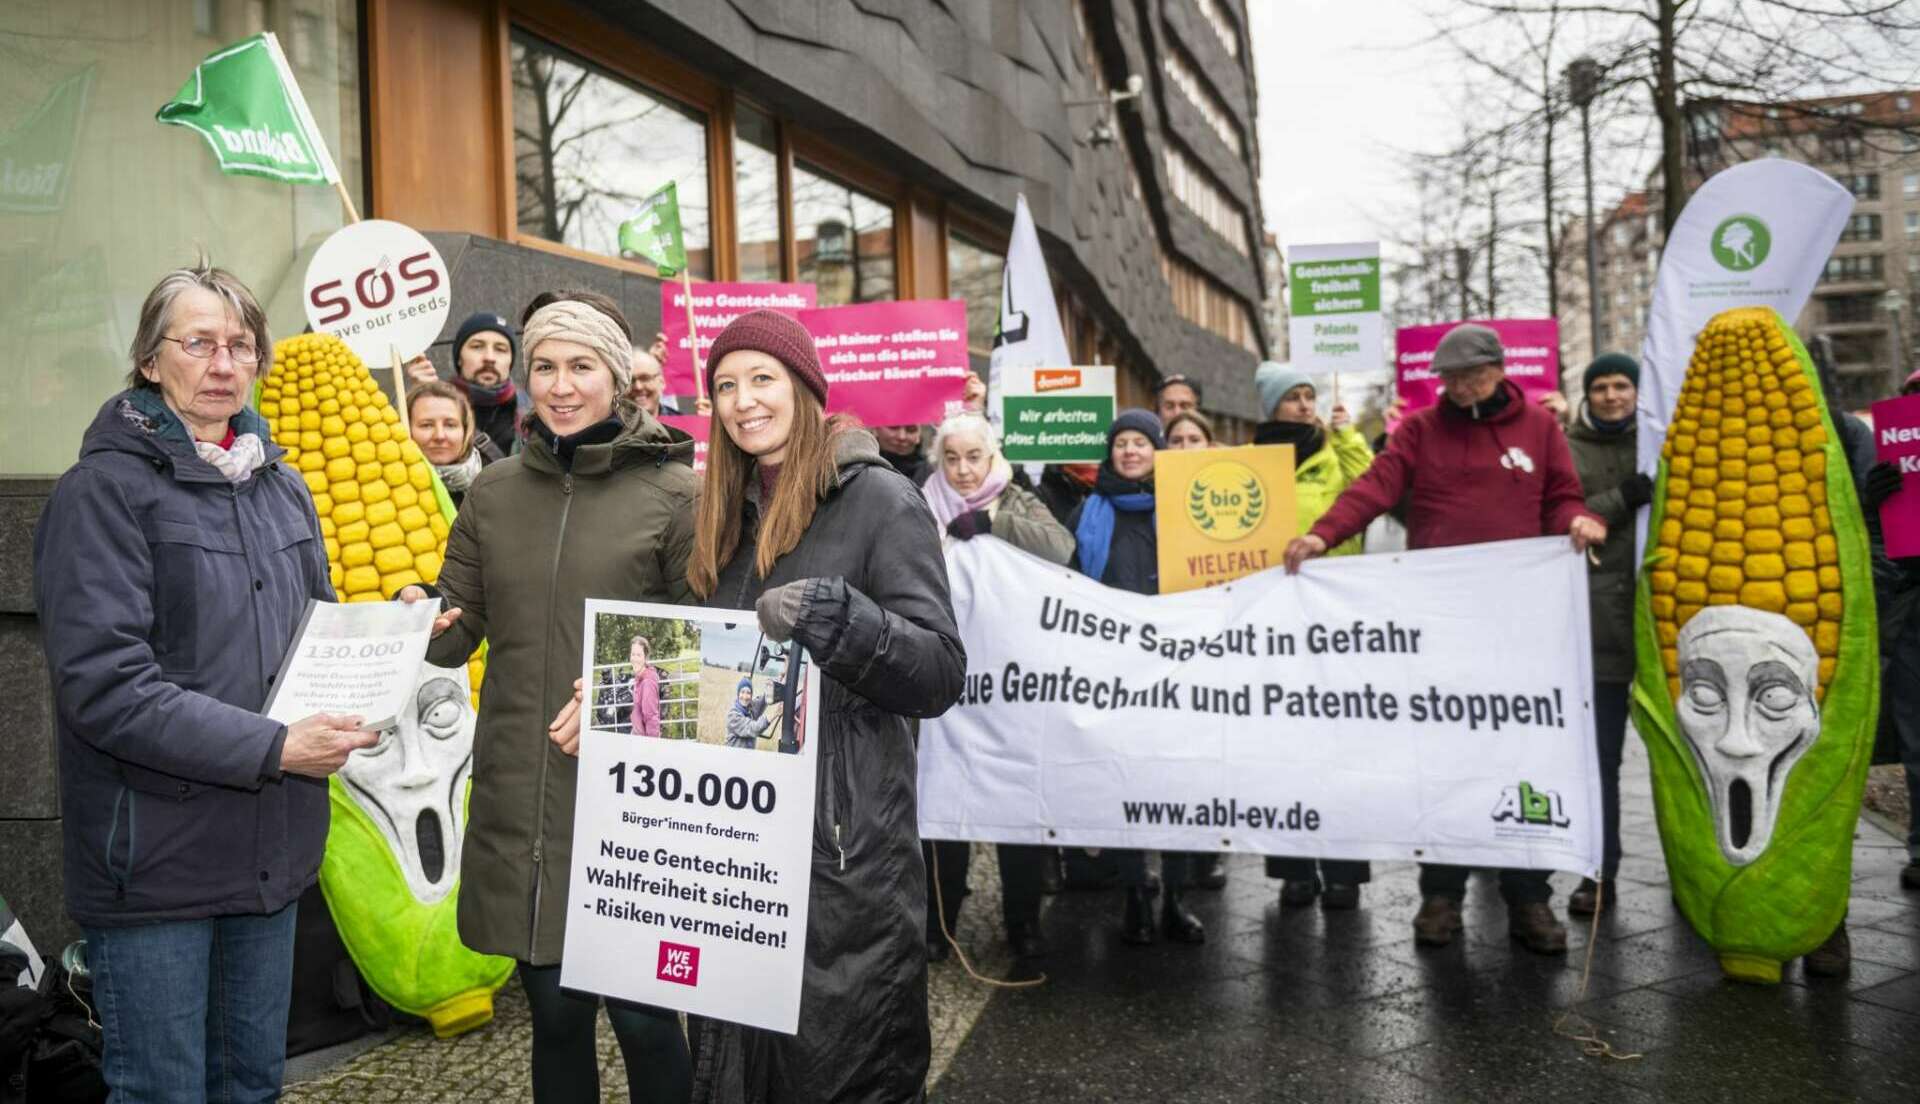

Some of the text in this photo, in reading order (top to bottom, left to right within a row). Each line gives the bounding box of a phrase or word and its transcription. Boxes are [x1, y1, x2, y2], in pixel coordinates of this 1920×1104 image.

[310, 252, 440, 326] SOS
[1311, 278, 1361, 294] freiheit
[674, 293, 807, 308] Nue Gentechnik:
[1313, 298, 1364, 311] sichern
[333, 296, 448, 338] ave our seeds
[839, 332, 881, 346] Rainer
[891, 329, 937, 343] stellen
[939, 329, 959, 341] Sie
[1314, 323, 1359, 336] Patente
[830, 347, 936, 364] sich an die Seite
[1314, 341, 1360, 356] stoppen
[1037, 375, 1077, 388] demeter
[1020, 408, 1097, 423] Wir arbeiten
[1005, 431, 1108, 446] ohne Gentechnik
[1210, 489, 1242, 507] bio
[1187, 550, 1268, 577] VIELFALT
[1039, 596, 1131, 644] Unser
[1266, 626, 1295, 656] in
[1307, 620, 1421, 654] Gefahr
[303, 641, 406, 659] 130.000
[1002, 661, 1181, 710] Gentechnik
[1191, 684, 1251, 716] und
[1263, 684, 1399, 721] Patente
[1409, 685, 1566, 731] stoppen!
[608, 761, 777, 814] 130.000
[1122, 798, 1320, 831] www.abl-ev.de
[705, 823, 760, 842] fordern:
[600, 839, 779, 885] Neue Gentechnik:
[586, 866, 789, 917] Wahlfreiheit sichern
[596, 898, 665, 926] Risiken
[669, 914, 787, 949] vermeiden!
[667, 948, 690, 965] WE
[661, 963, 693, 979] ACT
